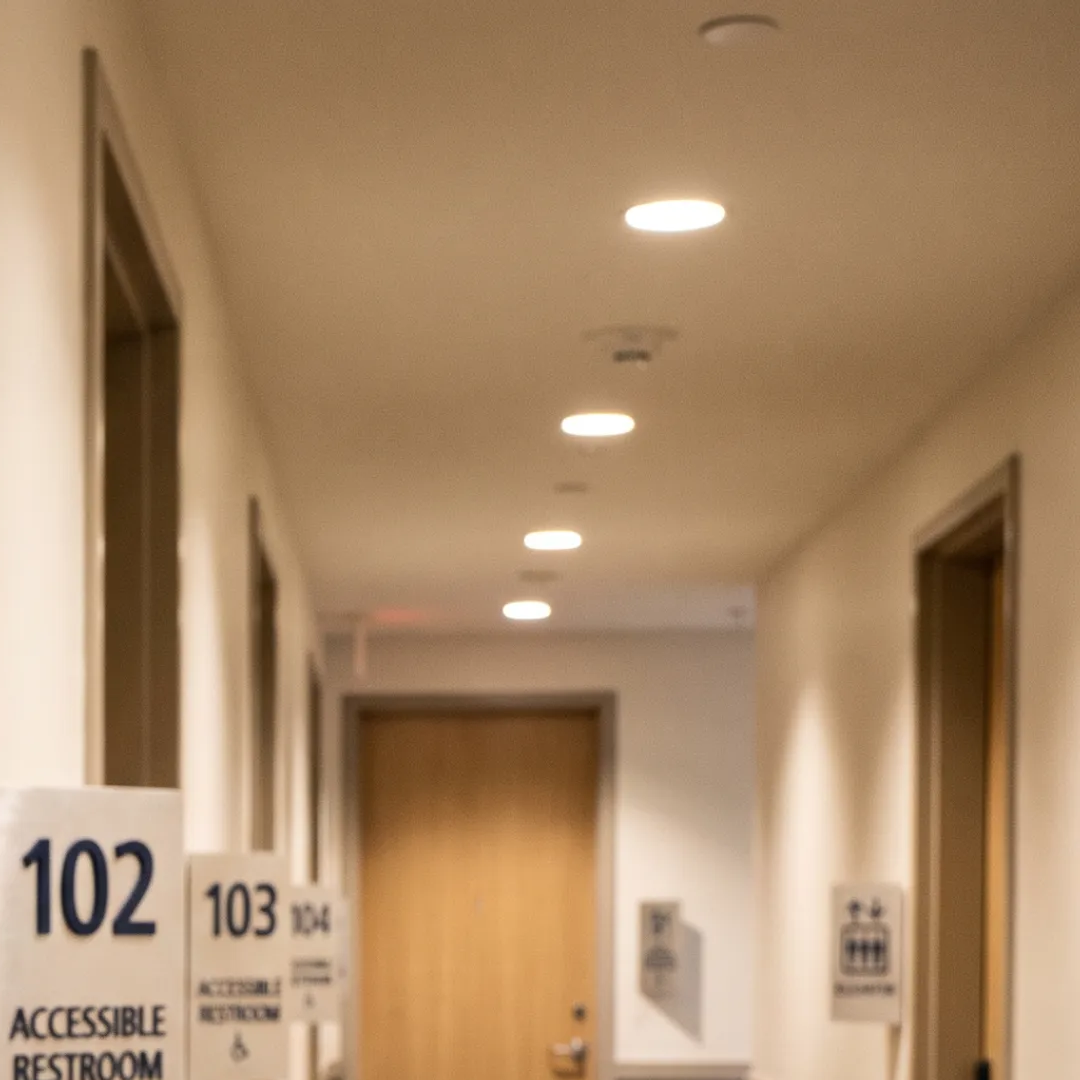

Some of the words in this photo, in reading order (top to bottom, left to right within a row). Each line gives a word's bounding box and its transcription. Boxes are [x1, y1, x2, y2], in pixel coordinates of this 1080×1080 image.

[22, 838, 157, 936] 102
[206, 882, 277, 938] 103
[290, 903, 332, 935] 104
[9, 1005, 166, 1041] ACCESSIBLE
